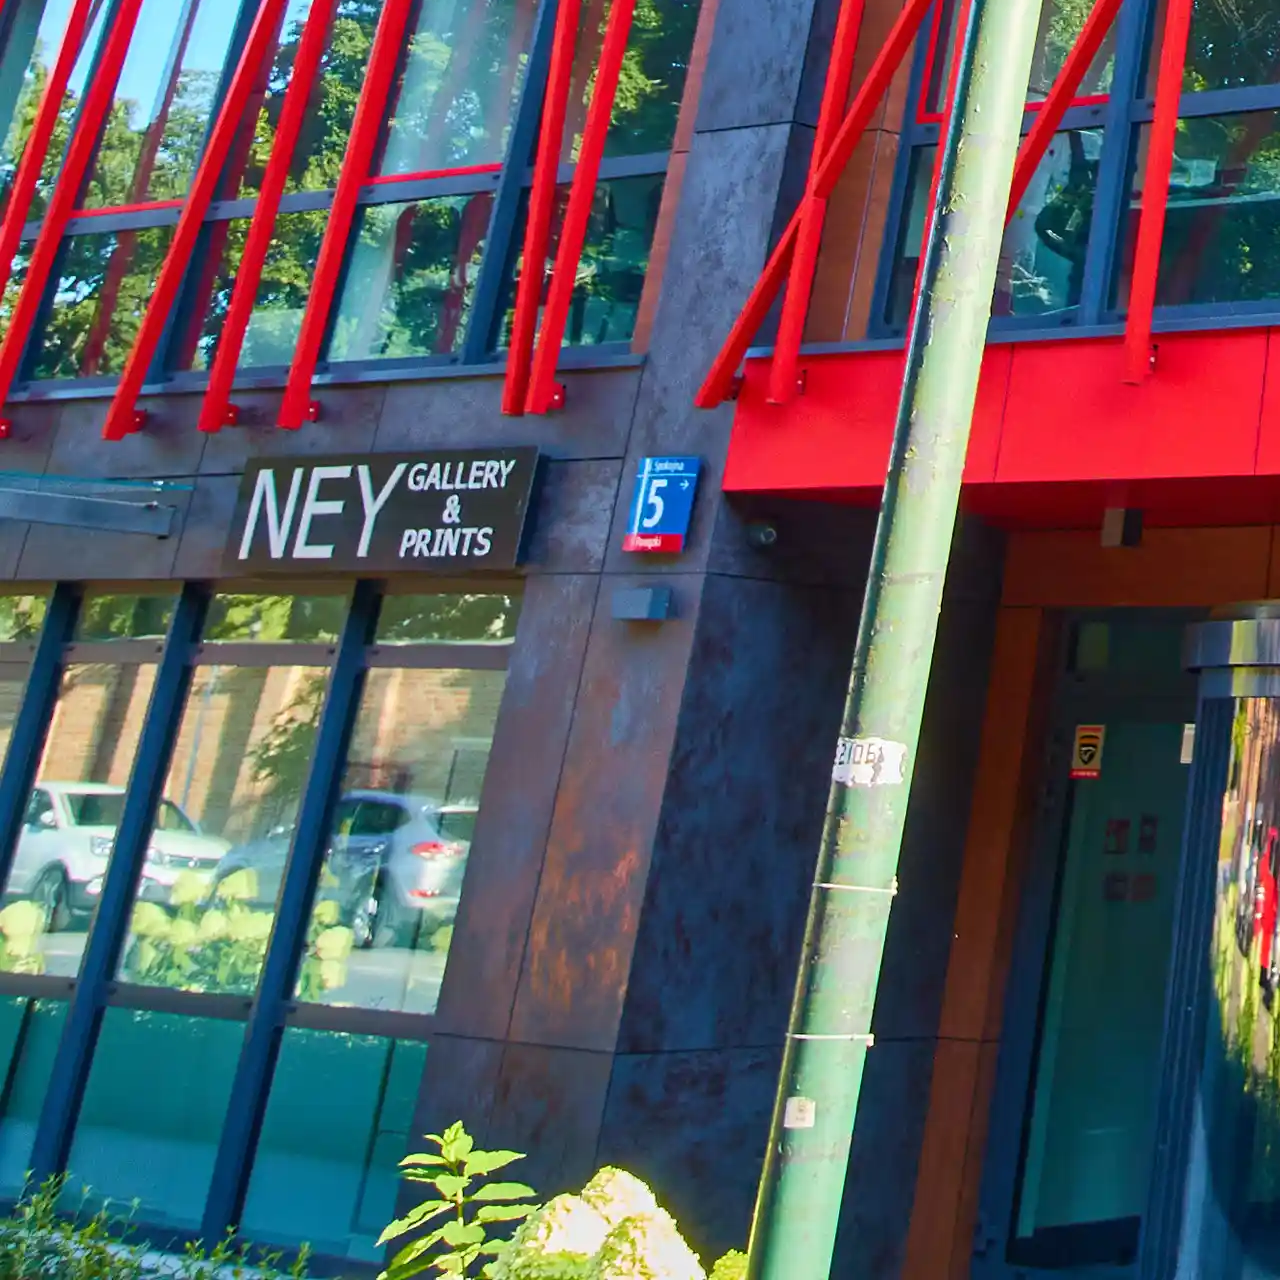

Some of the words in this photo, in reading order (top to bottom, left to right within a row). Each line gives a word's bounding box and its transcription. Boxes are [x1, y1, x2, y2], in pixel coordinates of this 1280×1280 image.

[407, 458, 517, 492] GALLERY
[237, 462, 409, 561] NEY
[441, 493, 462, 525] &
[641, 478, 668, 529] 5
[398, 526, 494, 558] PRINTS
